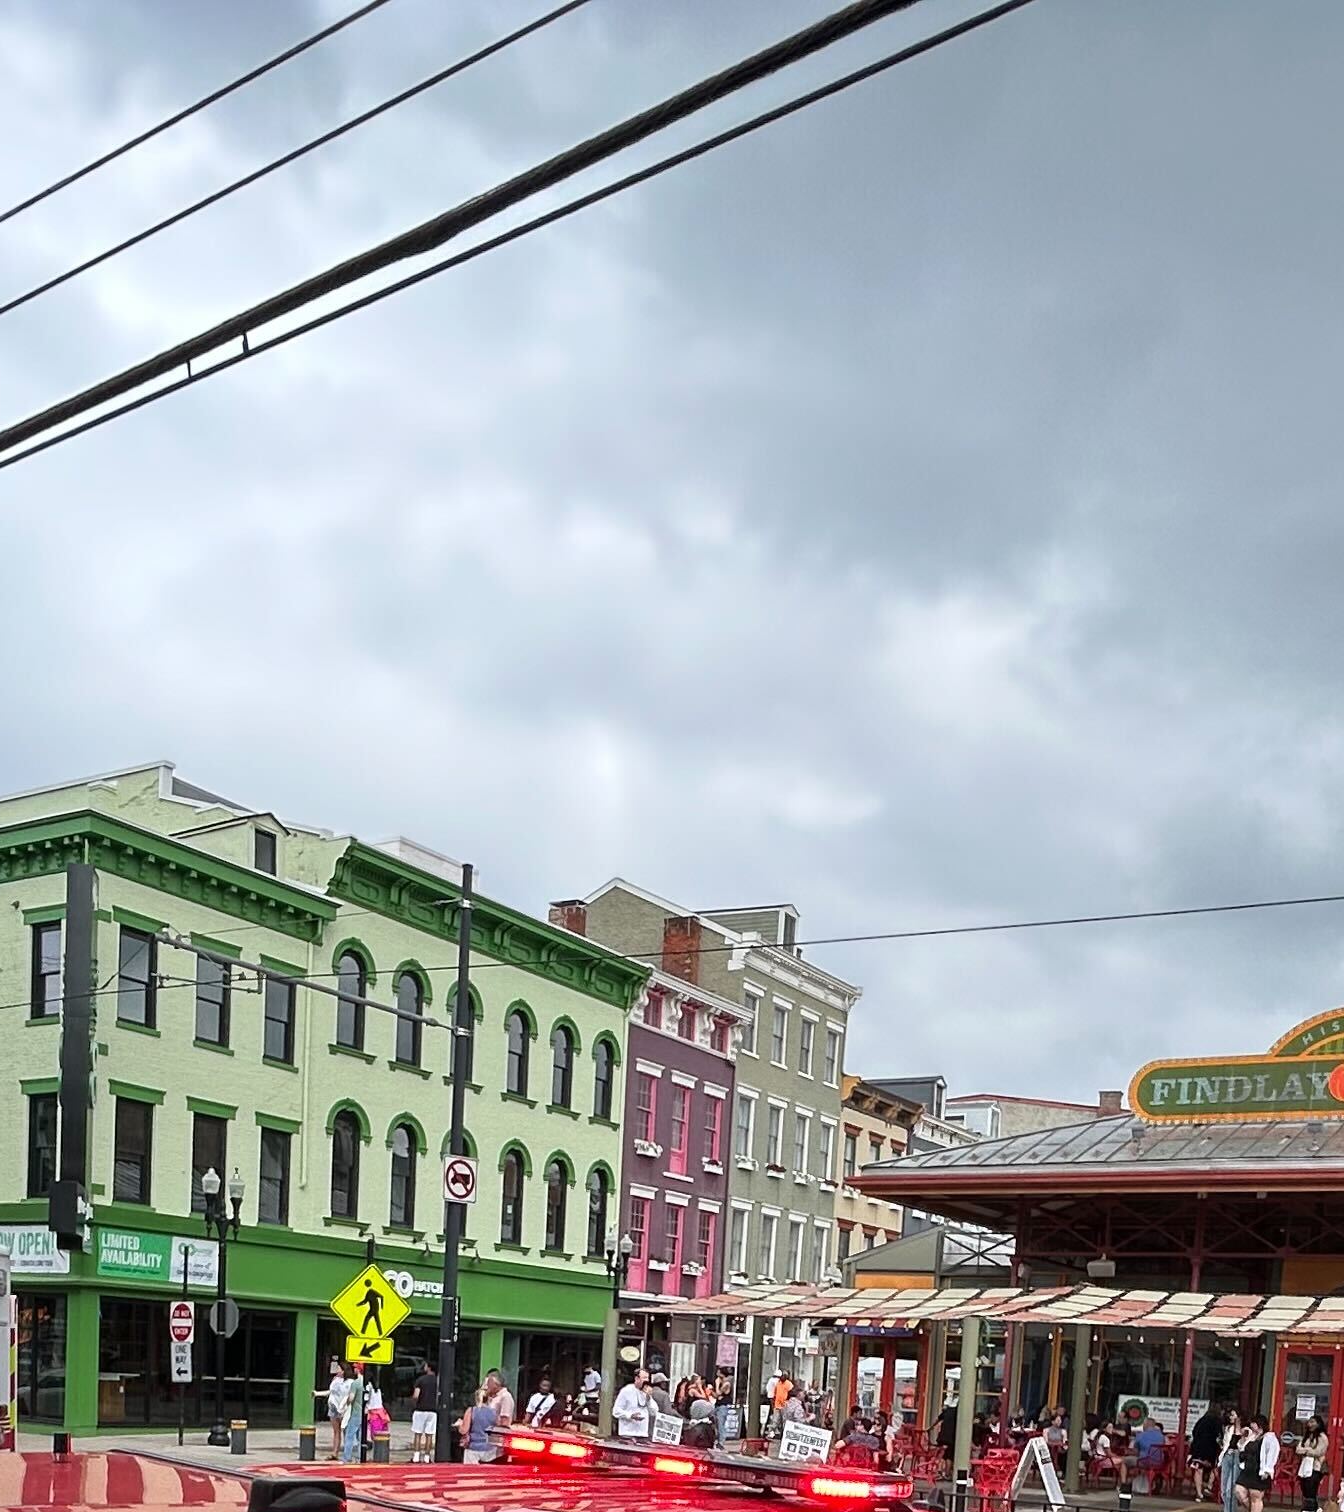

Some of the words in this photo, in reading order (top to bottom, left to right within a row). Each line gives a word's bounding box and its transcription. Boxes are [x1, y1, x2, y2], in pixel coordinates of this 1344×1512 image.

[1148, 1072, 1330, 1106] FINDLAY
[18, 1231, 55, 1256] OPEN!
[101, 1232, 140, 1250] LIMITED
[101, 1248, 163, 1268] AVAILABILITY
